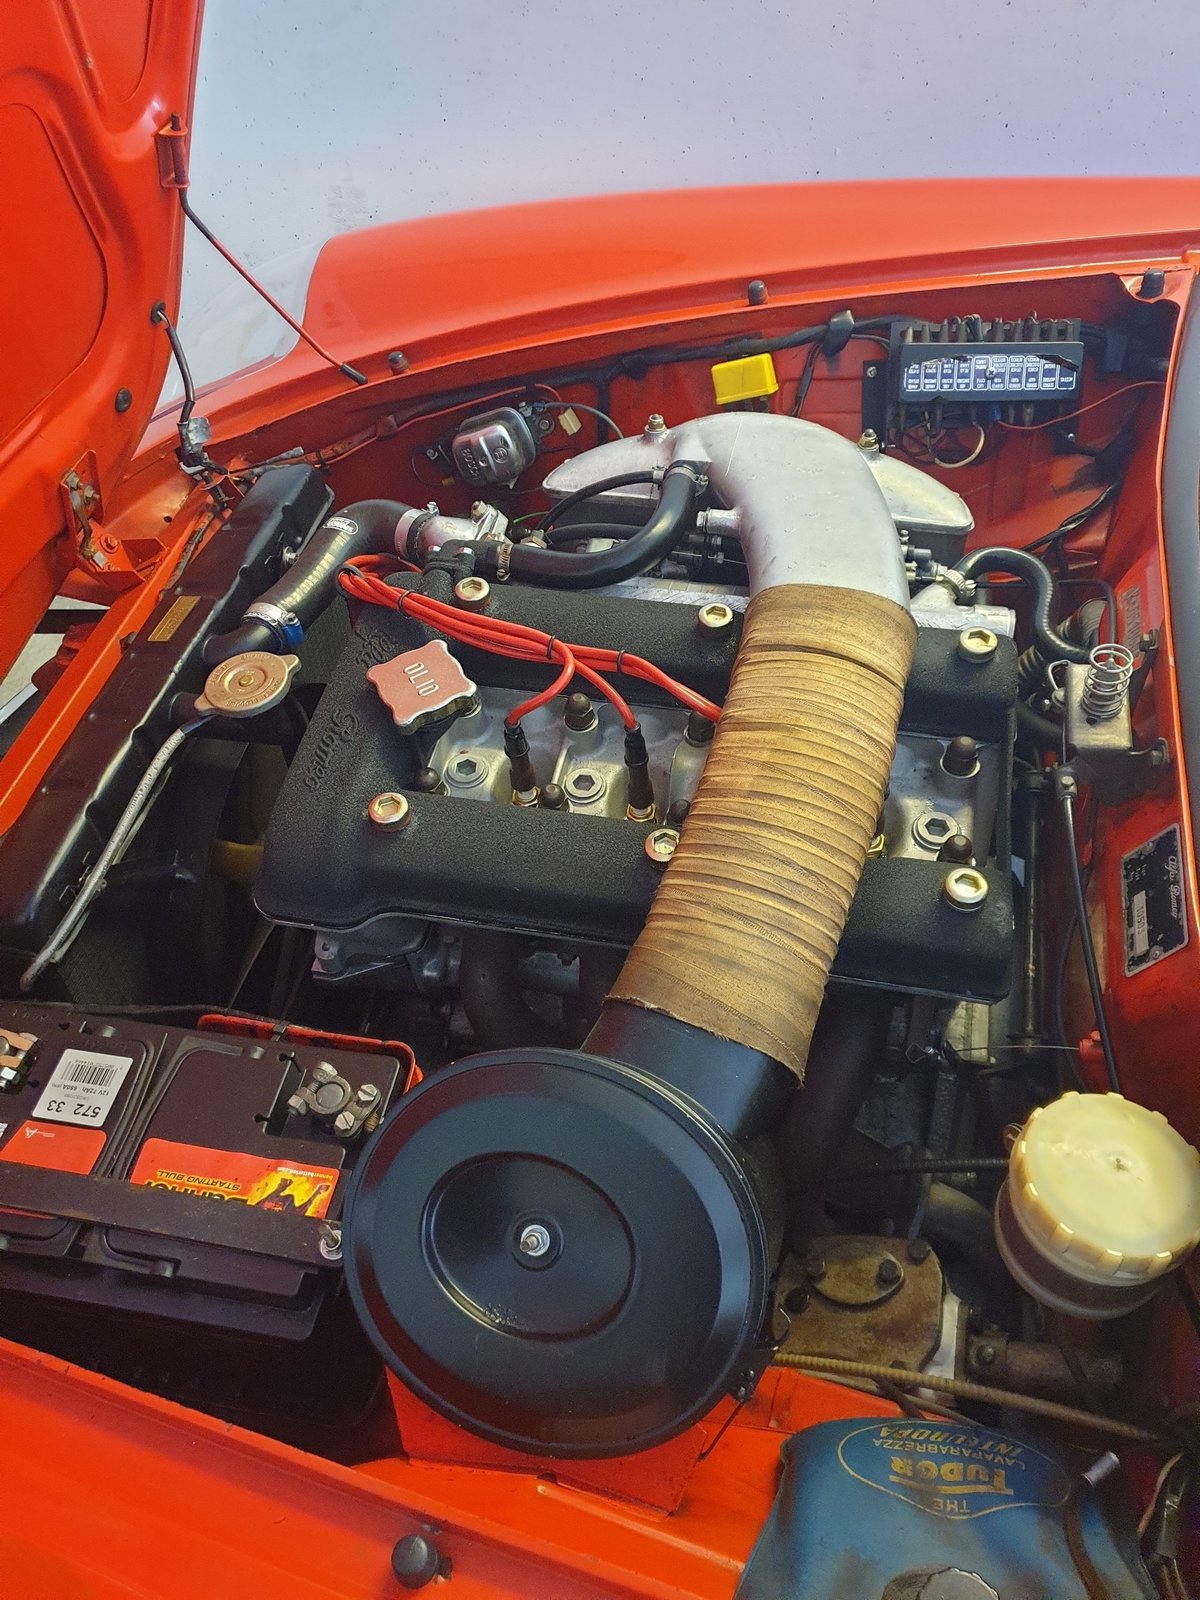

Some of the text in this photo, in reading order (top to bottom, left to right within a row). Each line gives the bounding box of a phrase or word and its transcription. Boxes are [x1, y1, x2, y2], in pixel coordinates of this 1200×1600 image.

[461, 447, 481, 482] BOSCH
[403, 662, 440, 697] OLIO
[304, 711, 359, 792] Romeo
[46, 1100, 102, 1118] 572 33
[156, 1169, 241, 1192] STARTING BULL
[888, 1455, 1014, 1496] TUDOR
[931, 1498, 970, 1513] THE
